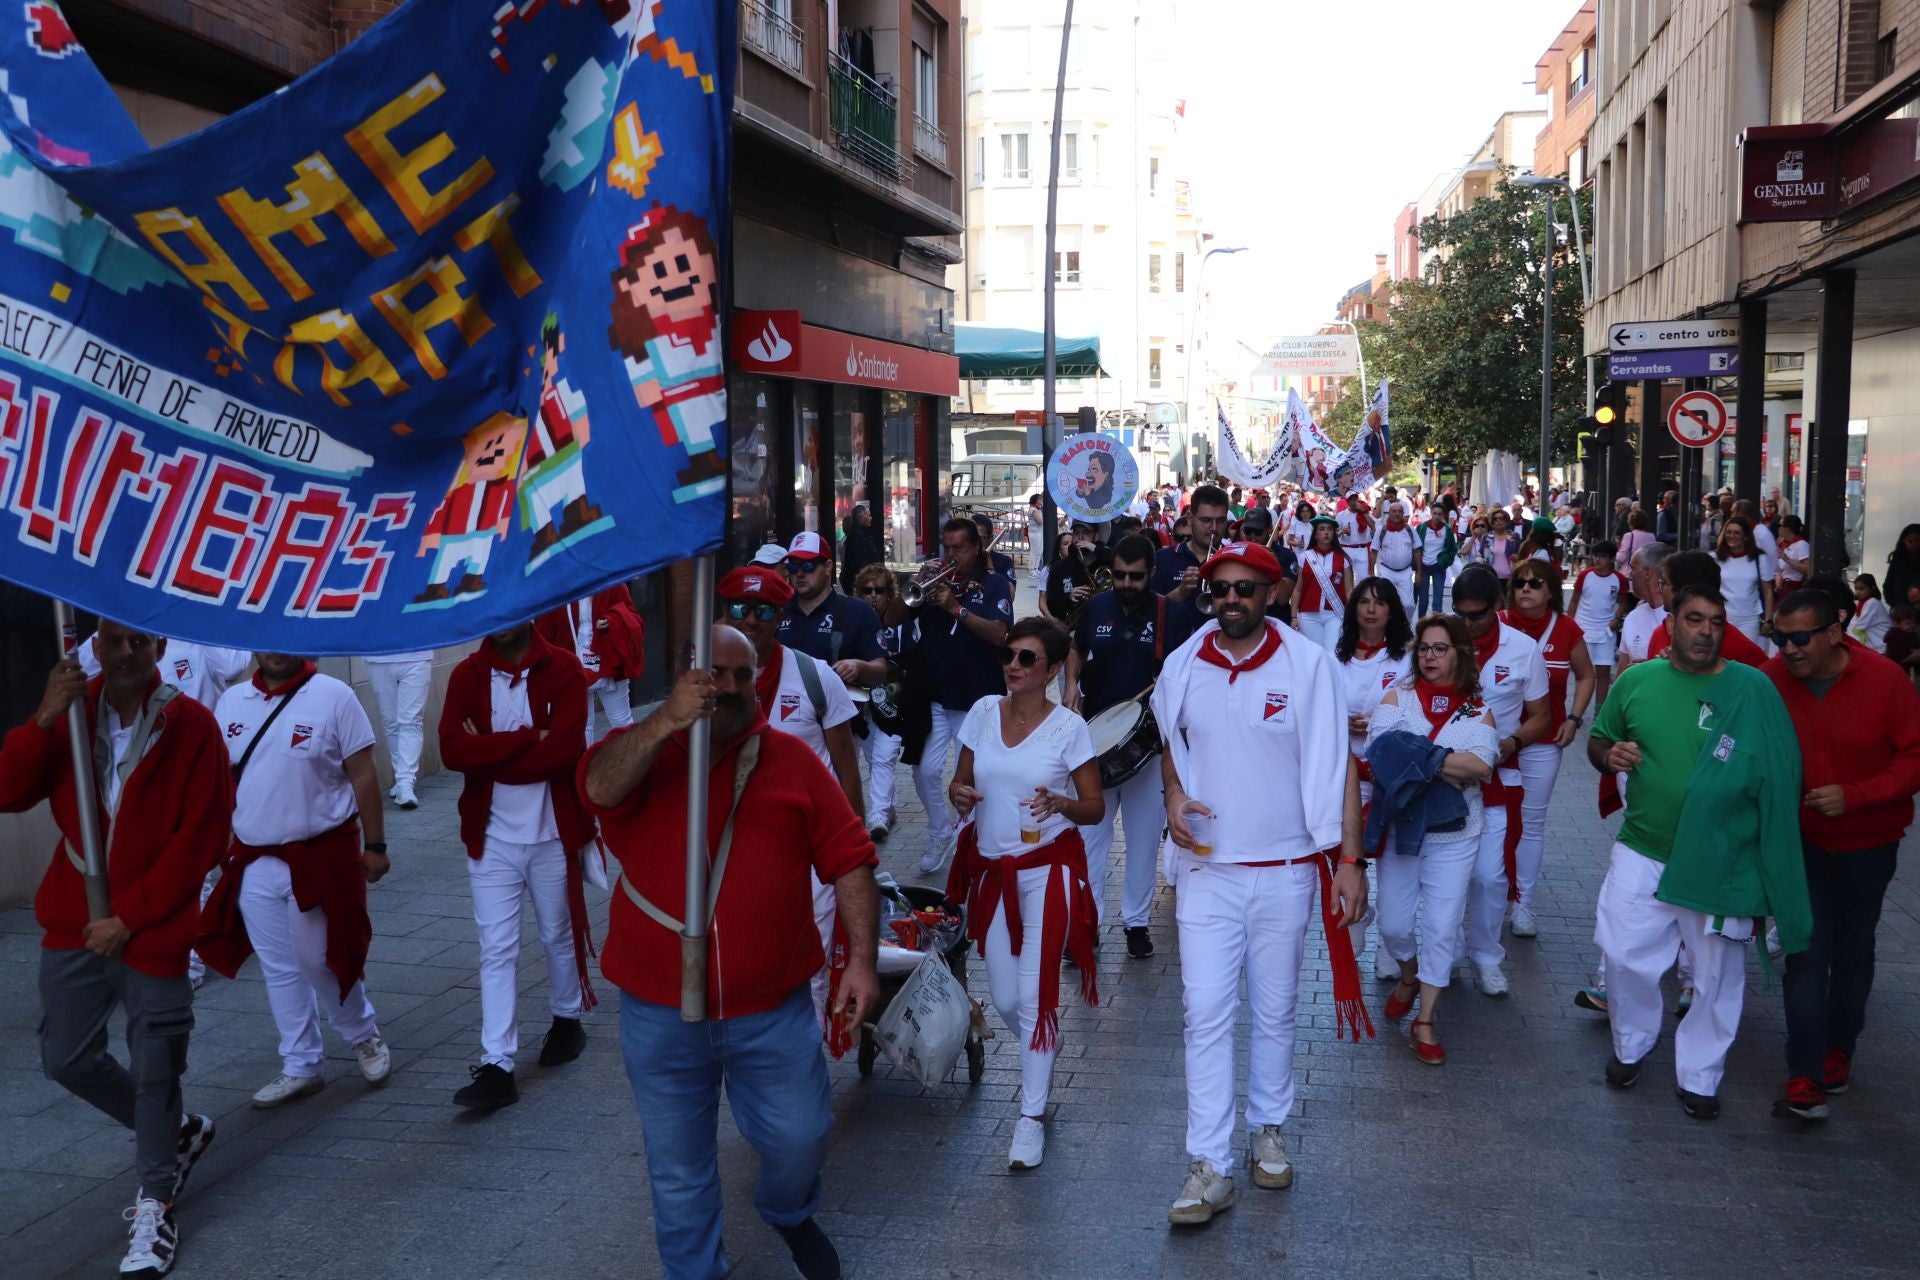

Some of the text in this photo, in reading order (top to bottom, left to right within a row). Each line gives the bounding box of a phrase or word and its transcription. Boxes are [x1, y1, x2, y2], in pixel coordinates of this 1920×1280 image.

[1755, 182, 1825, 198] GENERALI
[1772, 199, 1807, 208] Seguros
[1659, 328, 1740, 340] centro urba
[1304, 341, 1337, 349] TAURINO
[1263, 351, 1308, 359] ARNEDANO
[1323, 350, 1346, 358] DESEA
[1611, 355, 1637, 363] teatro
[858, 351, 898, 382] Santander
[1611, 364, 1672, 376] Cervantes
[74, 340, 151, 405] PEÑA
[159, 379, 202, 424] DE
[1096, 625, 1113, 633] CSV
